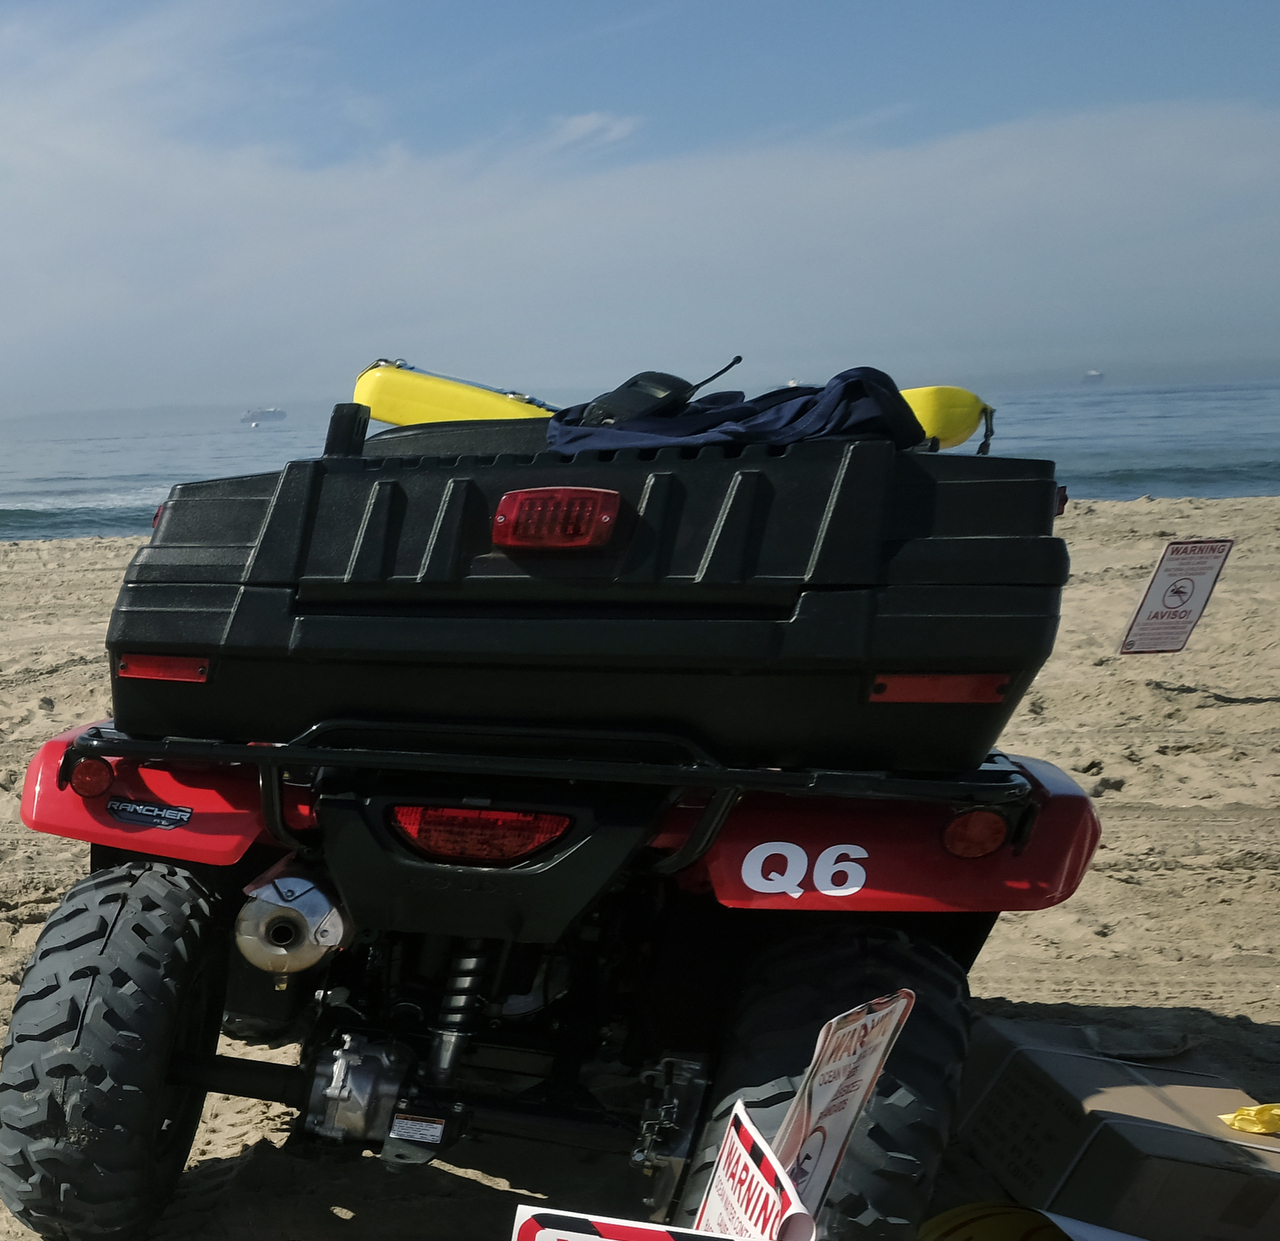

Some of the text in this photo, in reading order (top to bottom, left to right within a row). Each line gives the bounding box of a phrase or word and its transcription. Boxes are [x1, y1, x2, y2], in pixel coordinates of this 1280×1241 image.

[1170, 544, 1226, 556] WARNING
[1147, 610, 1192, 621] ¡AVISO!
[107, 800, 191, 822] RANCHER
[741, 841, 869, 899] Q6
